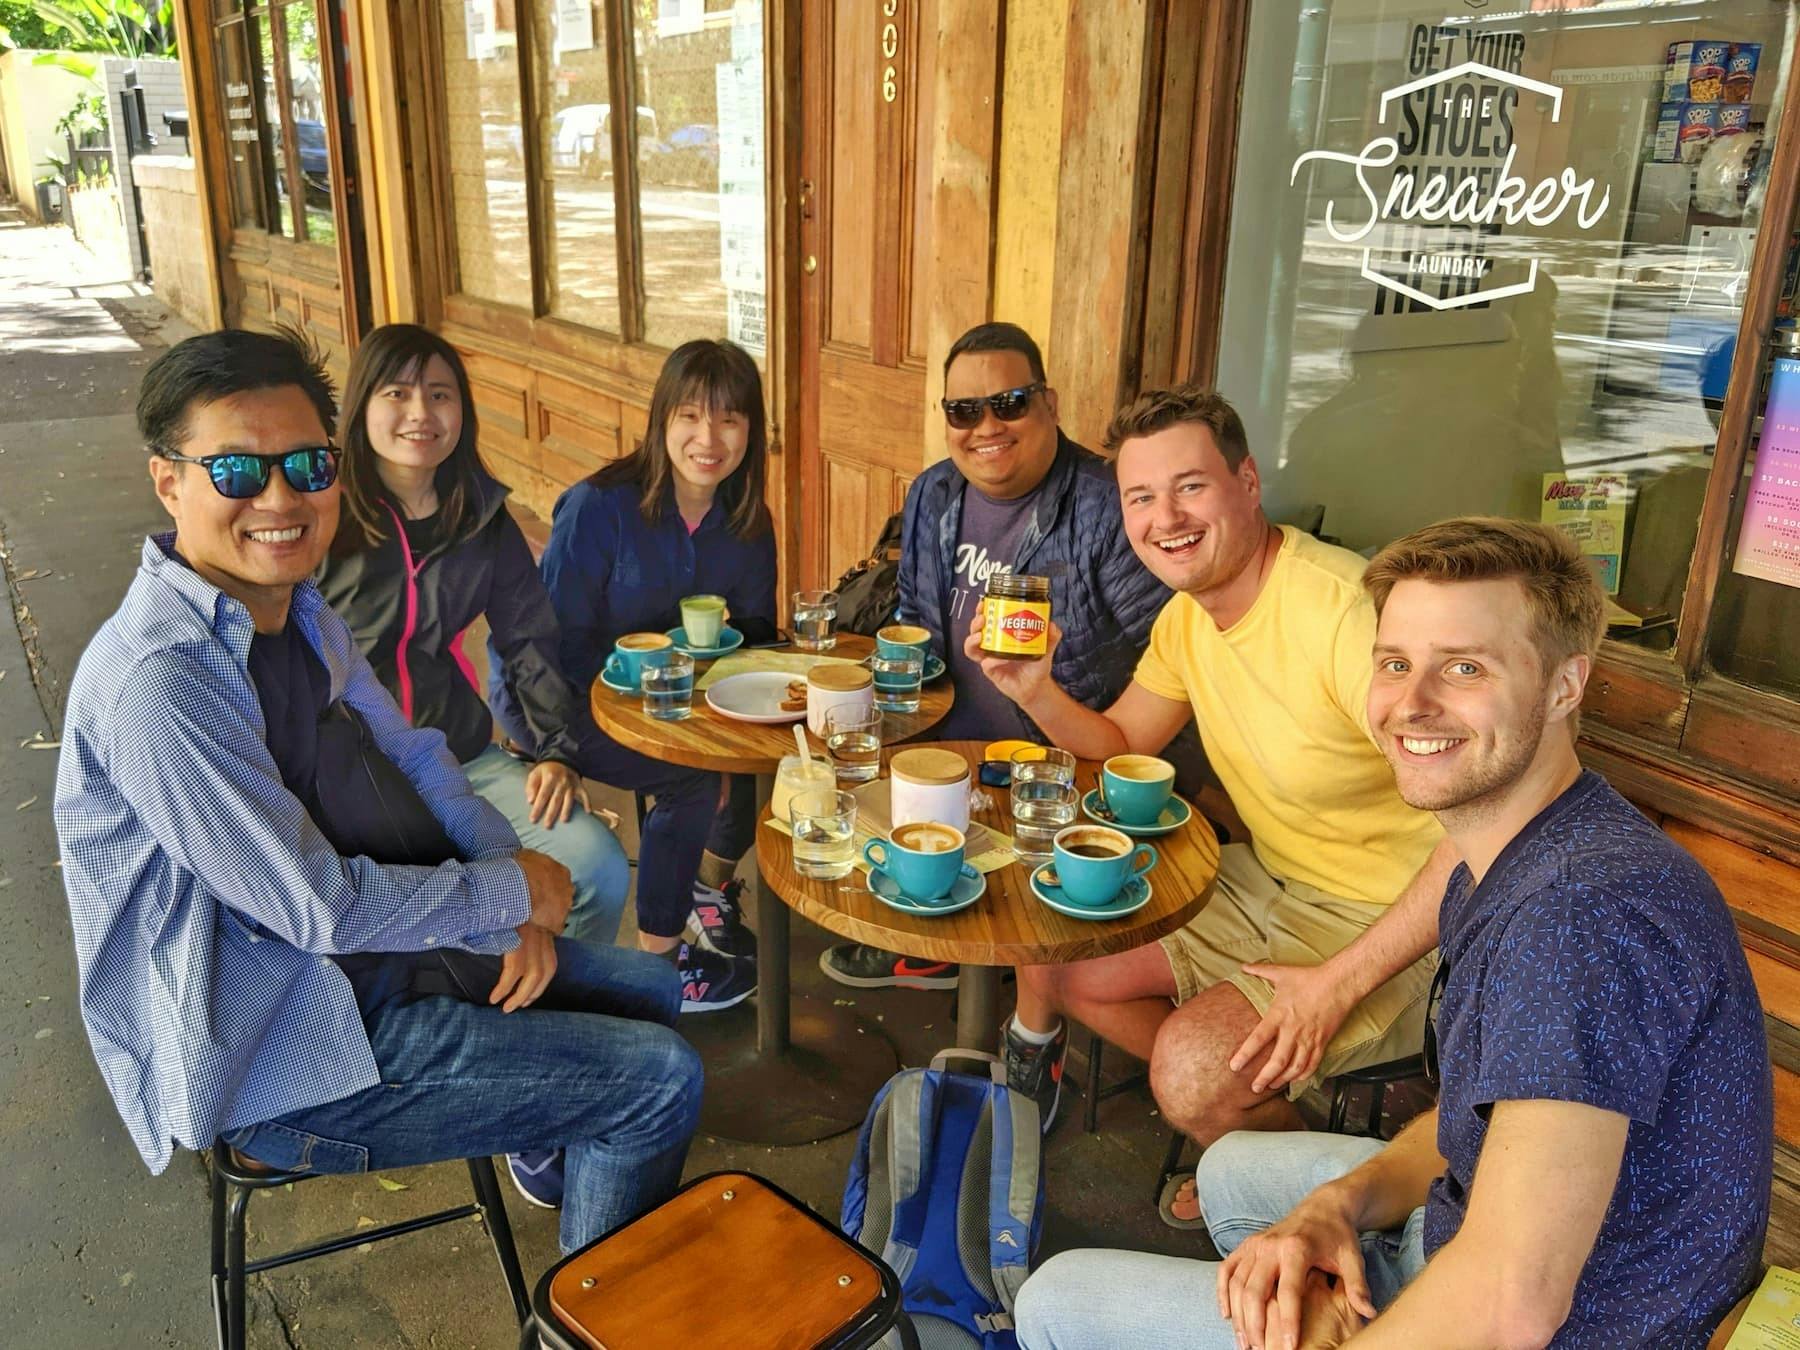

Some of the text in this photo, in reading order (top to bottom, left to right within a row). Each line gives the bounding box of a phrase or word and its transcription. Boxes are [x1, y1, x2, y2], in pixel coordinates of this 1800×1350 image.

[1410, 24, 1526, 80] GET YOUR
[1398, 80, 1519, 158] SHOES
[1443, 98, 1492, 119] THE
[1290, 136, 1611, 242] Sneaker
[1408, 254, 1487, 278] LAUNDRY
[999, 616, 1046, 632] VEGEMITE
